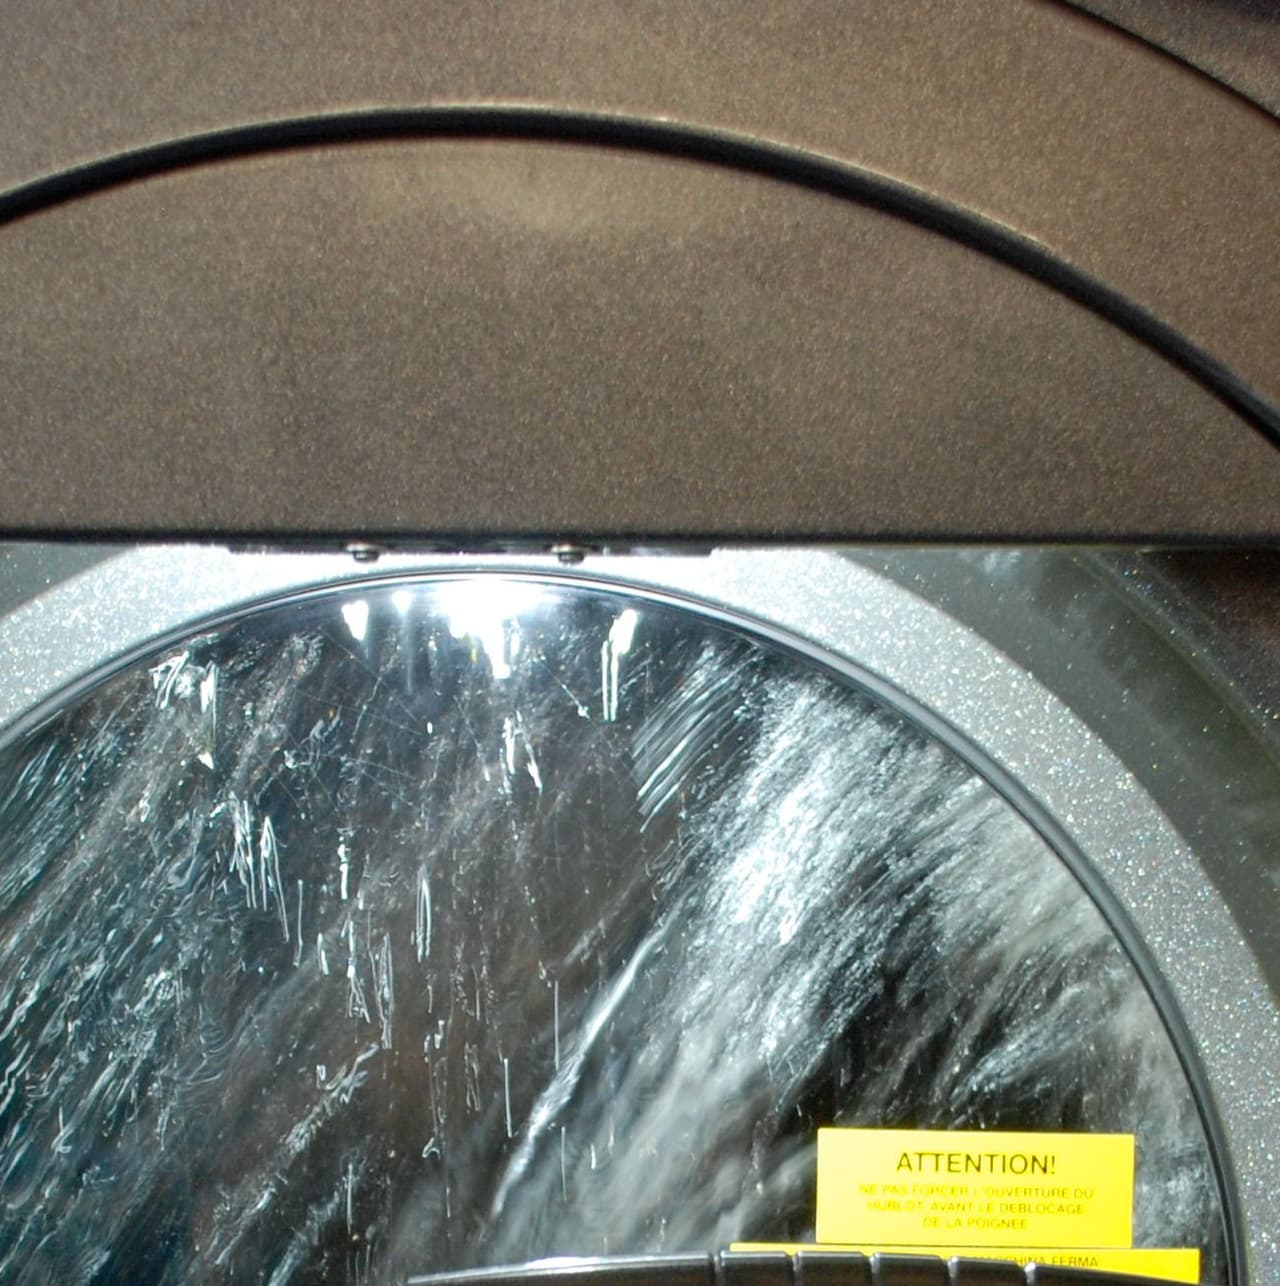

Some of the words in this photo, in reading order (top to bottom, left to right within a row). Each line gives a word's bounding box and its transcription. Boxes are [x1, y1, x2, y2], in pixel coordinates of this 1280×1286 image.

[896, 1152, 1057, 1175] ATTENTION!
[858, 1184, 877, 1195] NE
[882, 1184, 907, 1196] PAS
[912, 1185, 968, 1197] FORCER
[1074, 1187, 1095, 1200] DU
[866, 1200, 923, 1212] HUBLOT
[931, 1201, 973, 1213] AVANT
[978, 1202, 994, 1214] LE
[999, 1202, 1086, 1215] DEBLOCAGE
[922, 1216, 940, 1228] DE
[945, 1217, 962, 1229] LA
[967, 1217, 1029, 1230] POIGNEE
[1051, 1256, 1099, 1267] FERMA
